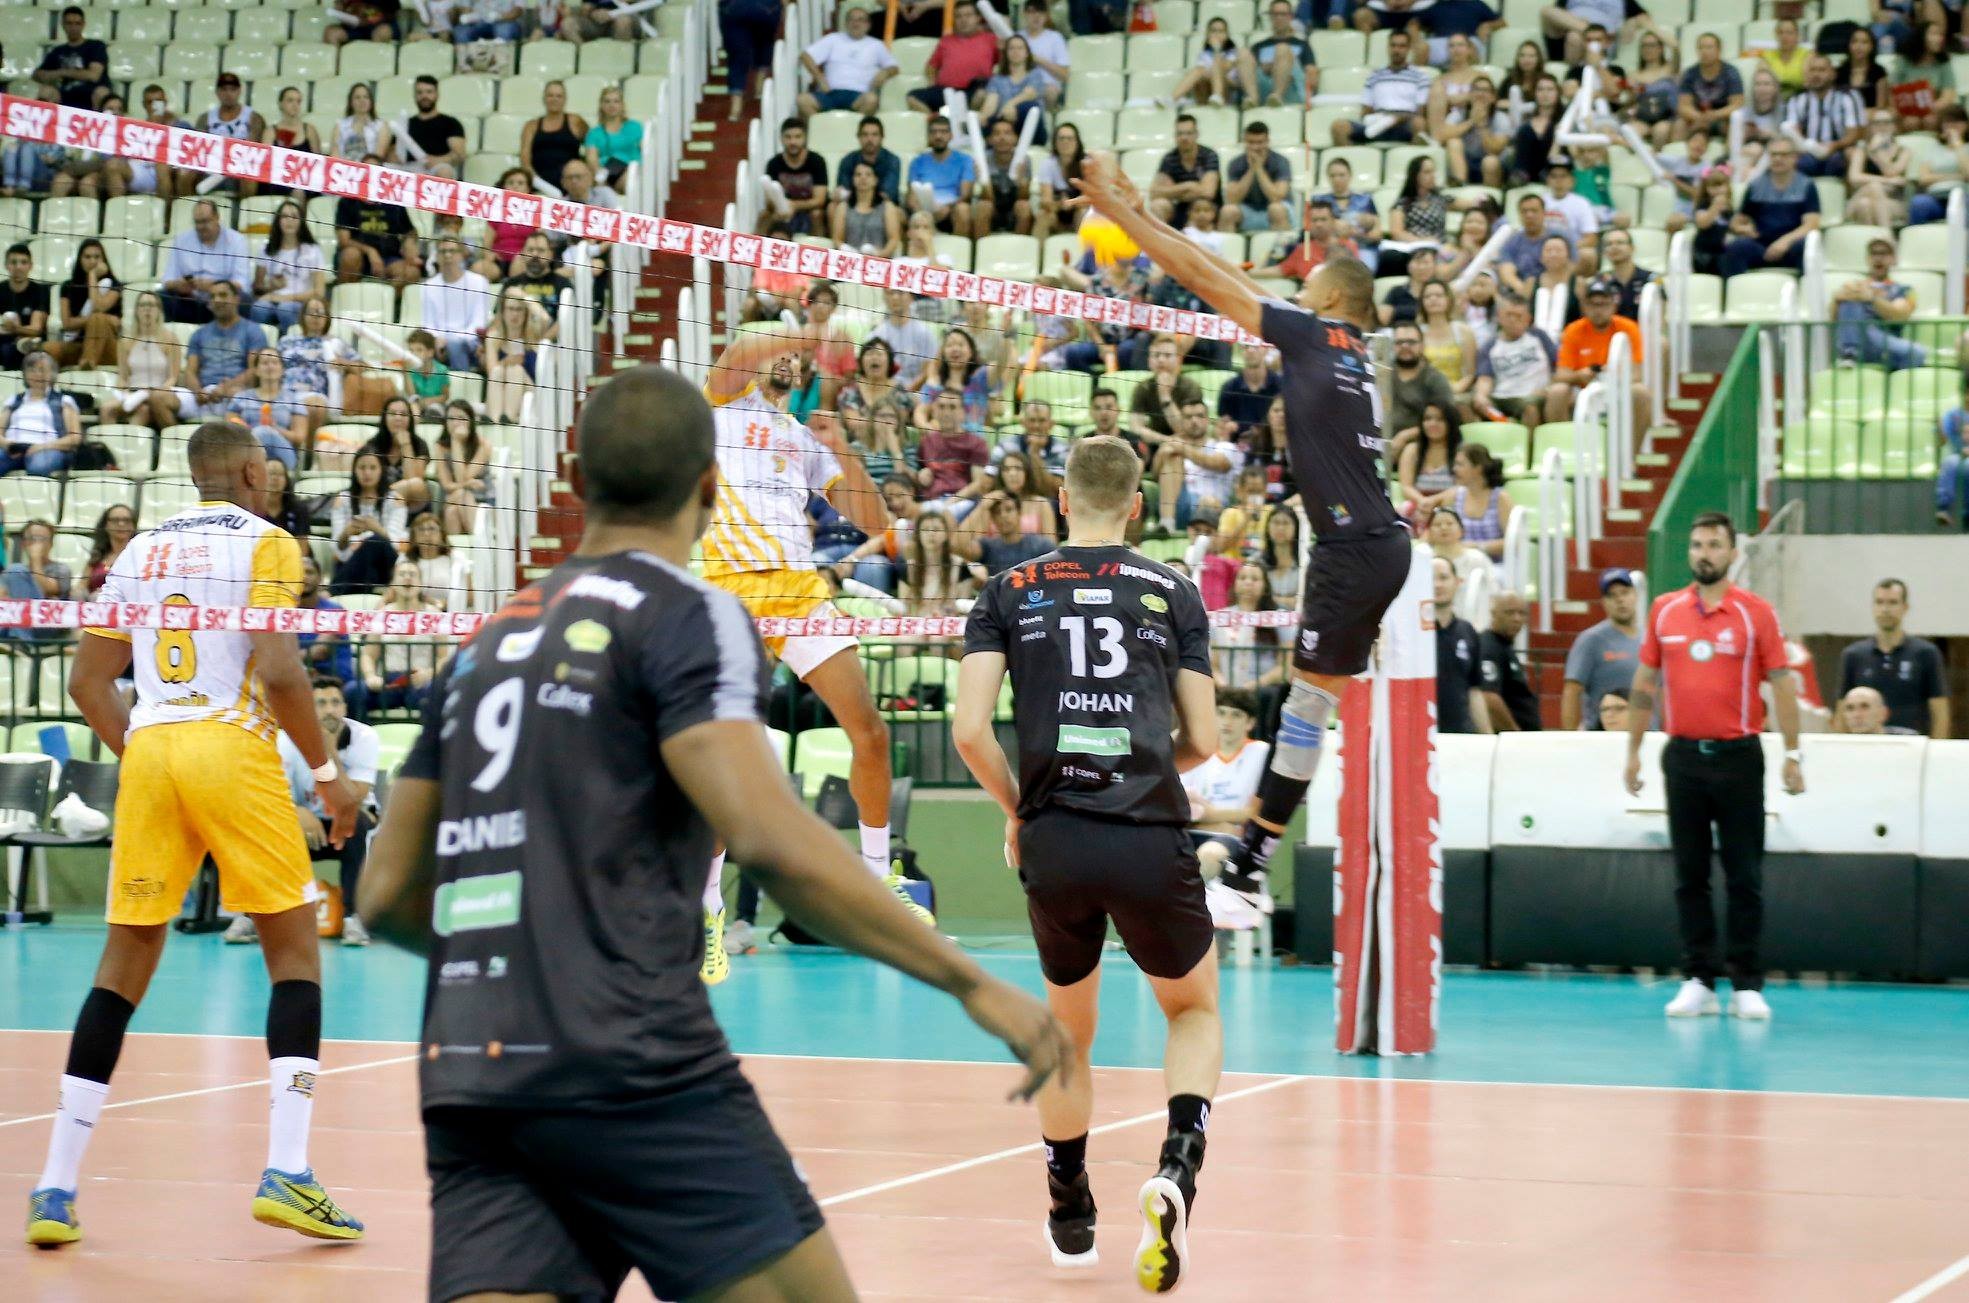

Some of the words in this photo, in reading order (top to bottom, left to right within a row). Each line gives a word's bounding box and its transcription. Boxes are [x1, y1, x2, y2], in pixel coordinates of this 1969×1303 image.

[5, 103, 52, 139] SKY
[66, 114, 110, 148] SKY
[120, 124, 165, 160] SKY
[177, 134, 216, 167] SKY
[226, 143, 267, 177] SKY
[282, 154, 318, 187] SKY
[327, 163, 365, 194] SKY
[376, 171, 410, 202] SKY
[419, 179, 456, 210] SKY
[466, 189, 498, 218] SKY
[505, 197, 539, 226] SKY
[550, 203, 579, 231] SKY
[586, 210, 618, 238] SKY
[628, 216, 654, 243] SKY
[661, 224, 691, 251] SKY
[700, 230, 726, 256] SKY
[732, 235, 761, 263] SKY
[770, 242, 794, 268] SKY
[801, 249, 826, 275] SKY
[1044, 562, 1082, 571] COPEL
[1044, 571, 1091, 580] Telecom
[39, 602, 64, 625] SKY
[80, 604, 111, 625] SKY
[124, 604, 150, 626] SKY
[164, 606, 193, 628] SKY
[205, 608, 230, 629] SKY
[242, 609, 269, 630] SKY
[154, 593, 197, 684] 8
[1059, 616, 1129, 679] 13
[1058, 691, 1133, 713] JOHAN
[470, 676, 525, 793] 9
[1064, 734, 1107, 747] Unimed
[436, 809, 526, 856] DANIE
